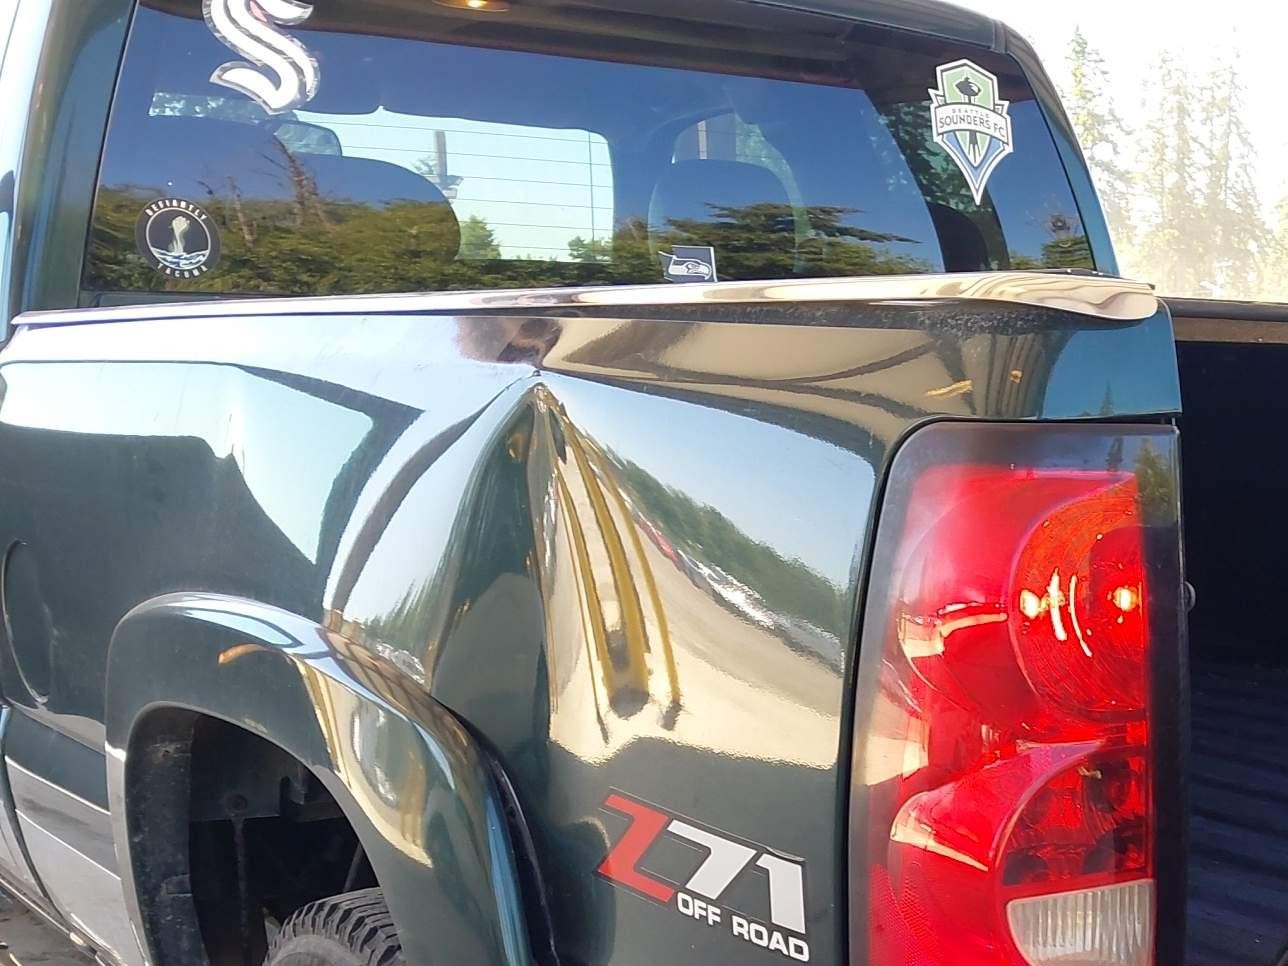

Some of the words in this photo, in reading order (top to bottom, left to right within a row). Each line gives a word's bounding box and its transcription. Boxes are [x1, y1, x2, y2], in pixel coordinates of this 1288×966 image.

[938, 114, 991, 130] SOUNDERS
[993, 122, 1006, 138] FC
[951, 107, 990, 119] SEATTLE
[597, 793, 807, 935] Z71
[676, 891, 721, 927] OFF
[731, 914, 810, 963] ROAD
